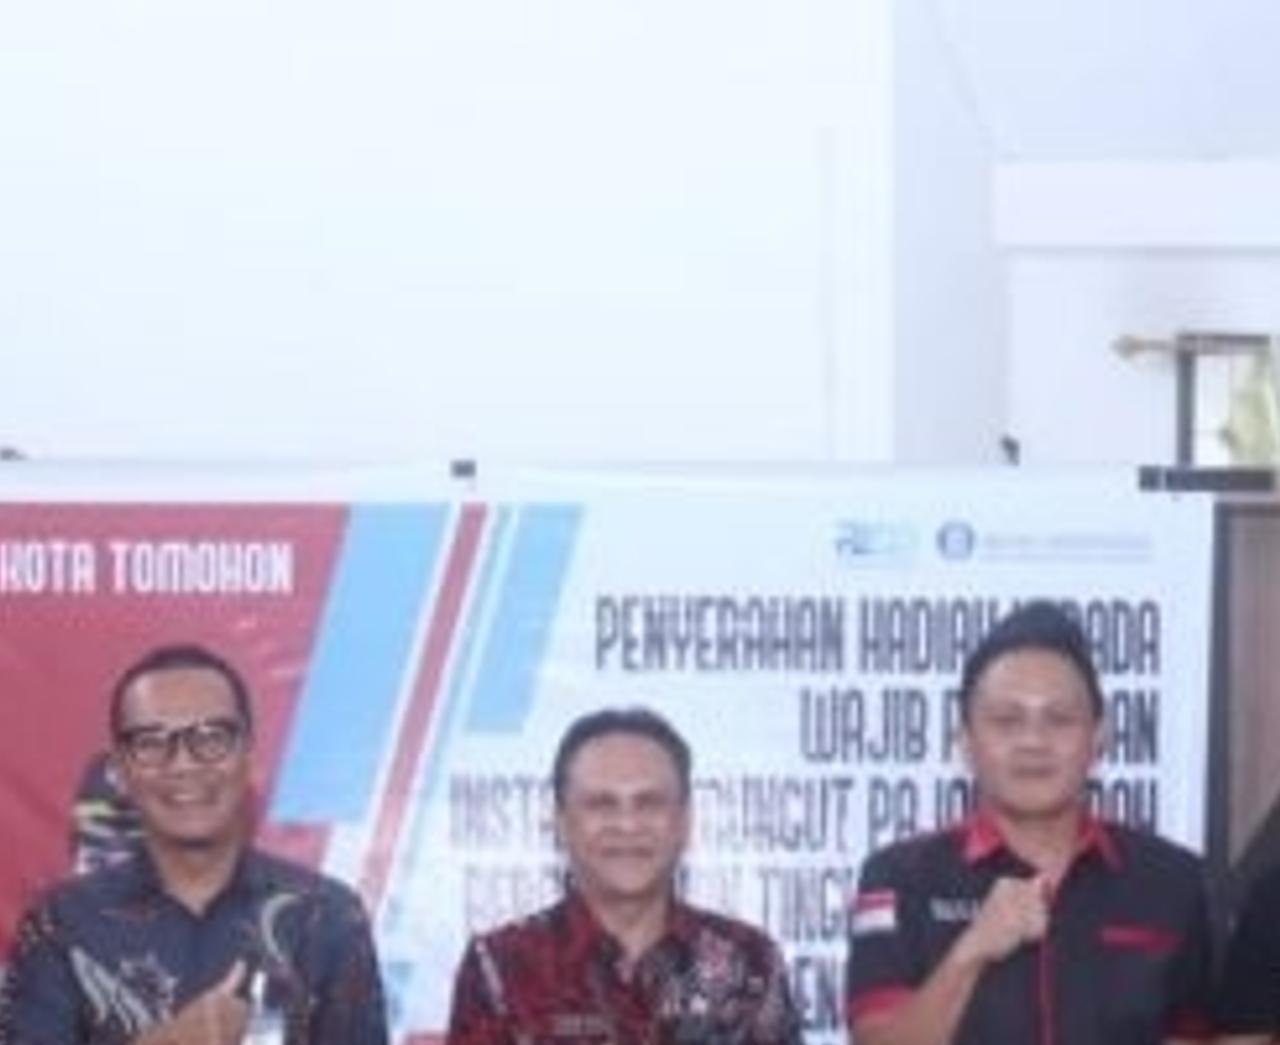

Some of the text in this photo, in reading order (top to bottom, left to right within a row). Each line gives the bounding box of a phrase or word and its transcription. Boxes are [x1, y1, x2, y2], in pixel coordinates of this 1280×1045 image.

[0, 540, 96, 593] KOTA
[110, 540, 294, 594] TOMOHON
[594, 595, 844, 672] PENYERAHAN
[799, 688, 928, 764] WAJIB
